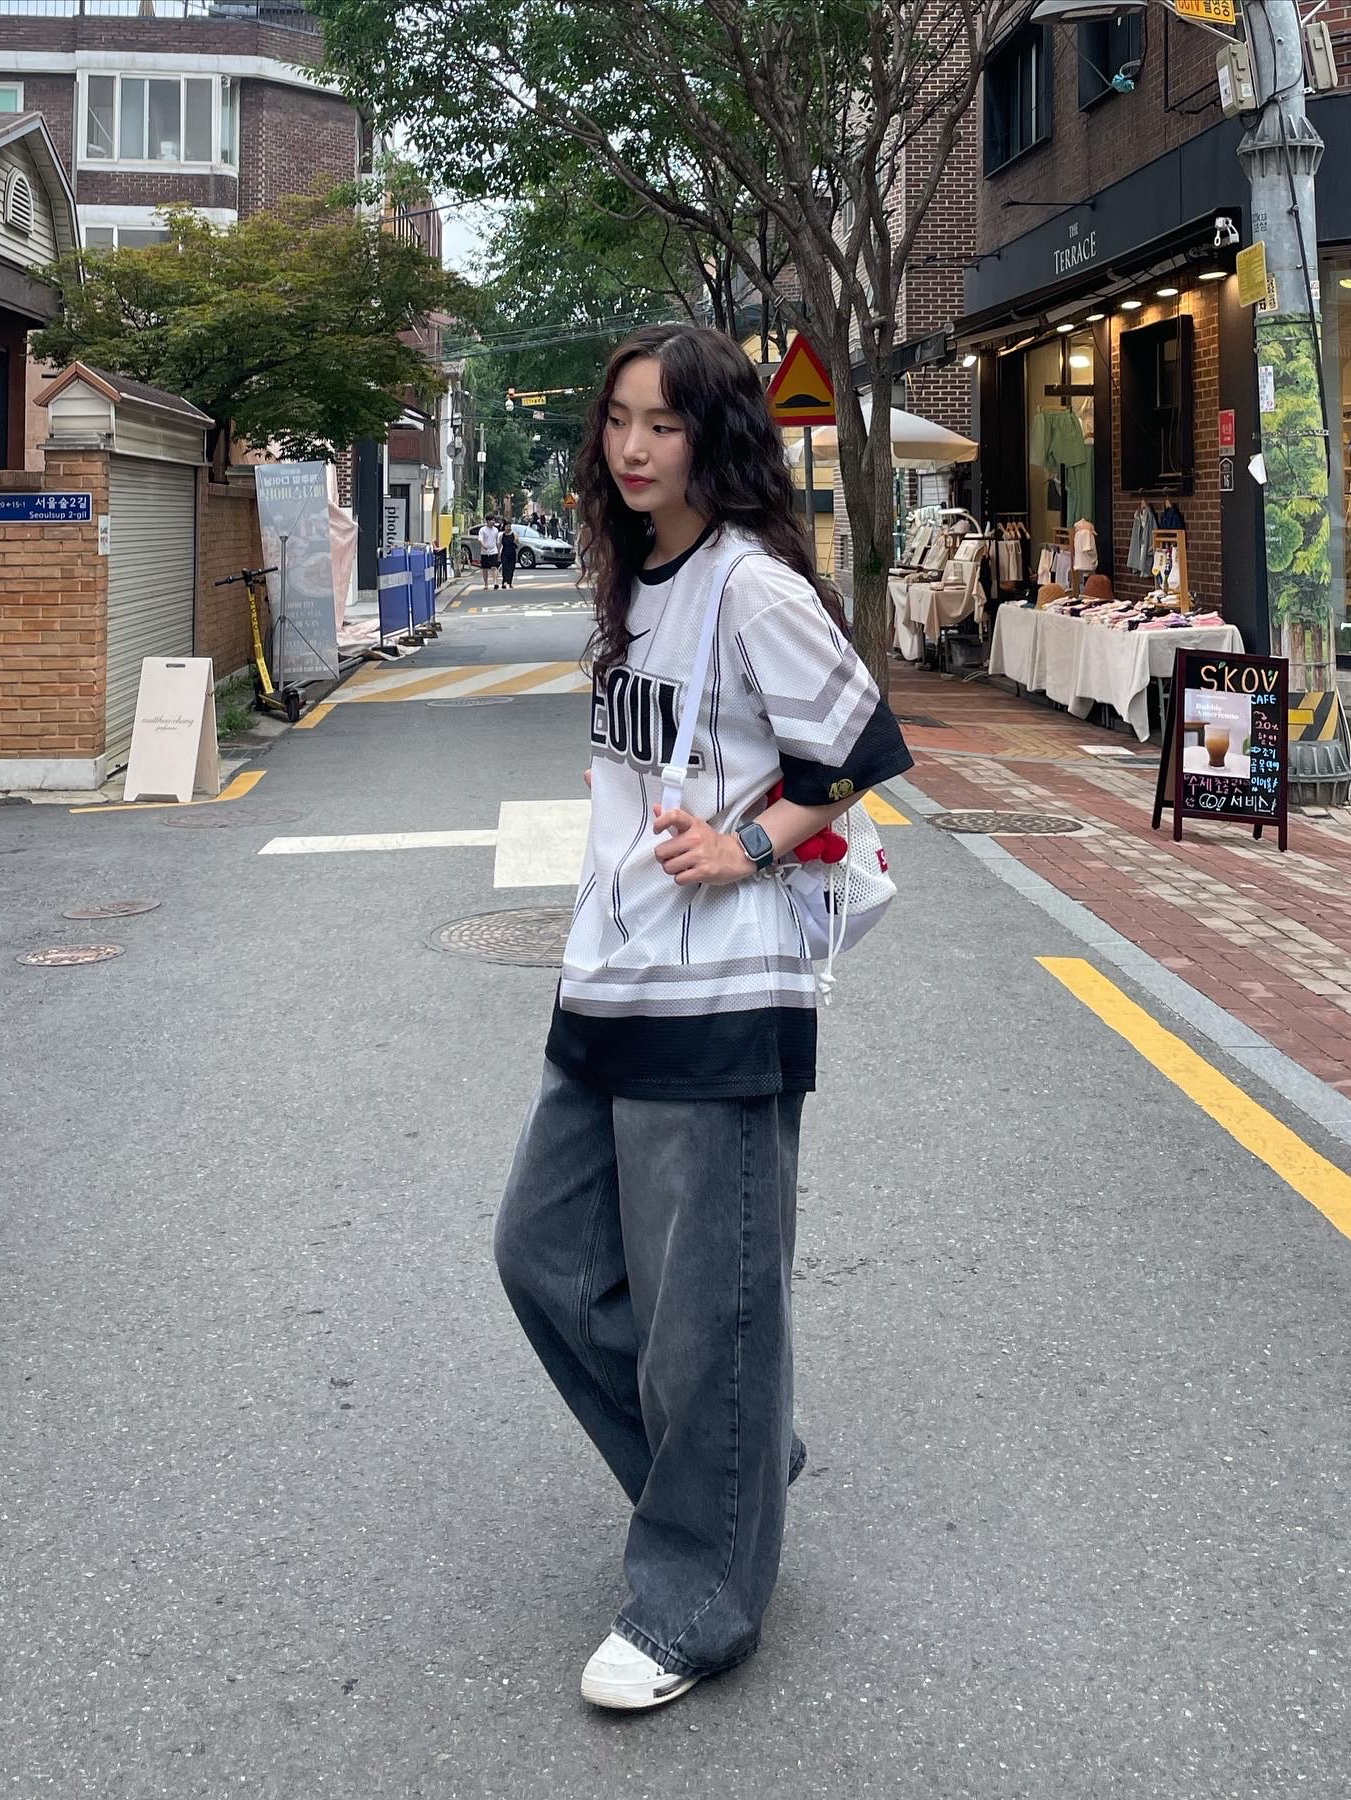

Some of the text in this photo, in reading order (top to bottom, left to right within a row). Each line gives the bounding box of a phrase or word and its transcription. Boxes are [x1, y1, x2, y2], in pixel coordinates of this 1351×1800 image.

[1053, 231, 1097, 275] TERRACE
[35, 496, 87, 510] 서울숲2길
[29, 511, 87, 520] Seoulsup 2-gil
[1200, 664, 1279, 693] SKOV
[1250, 694, 1277, 705] CAFE
